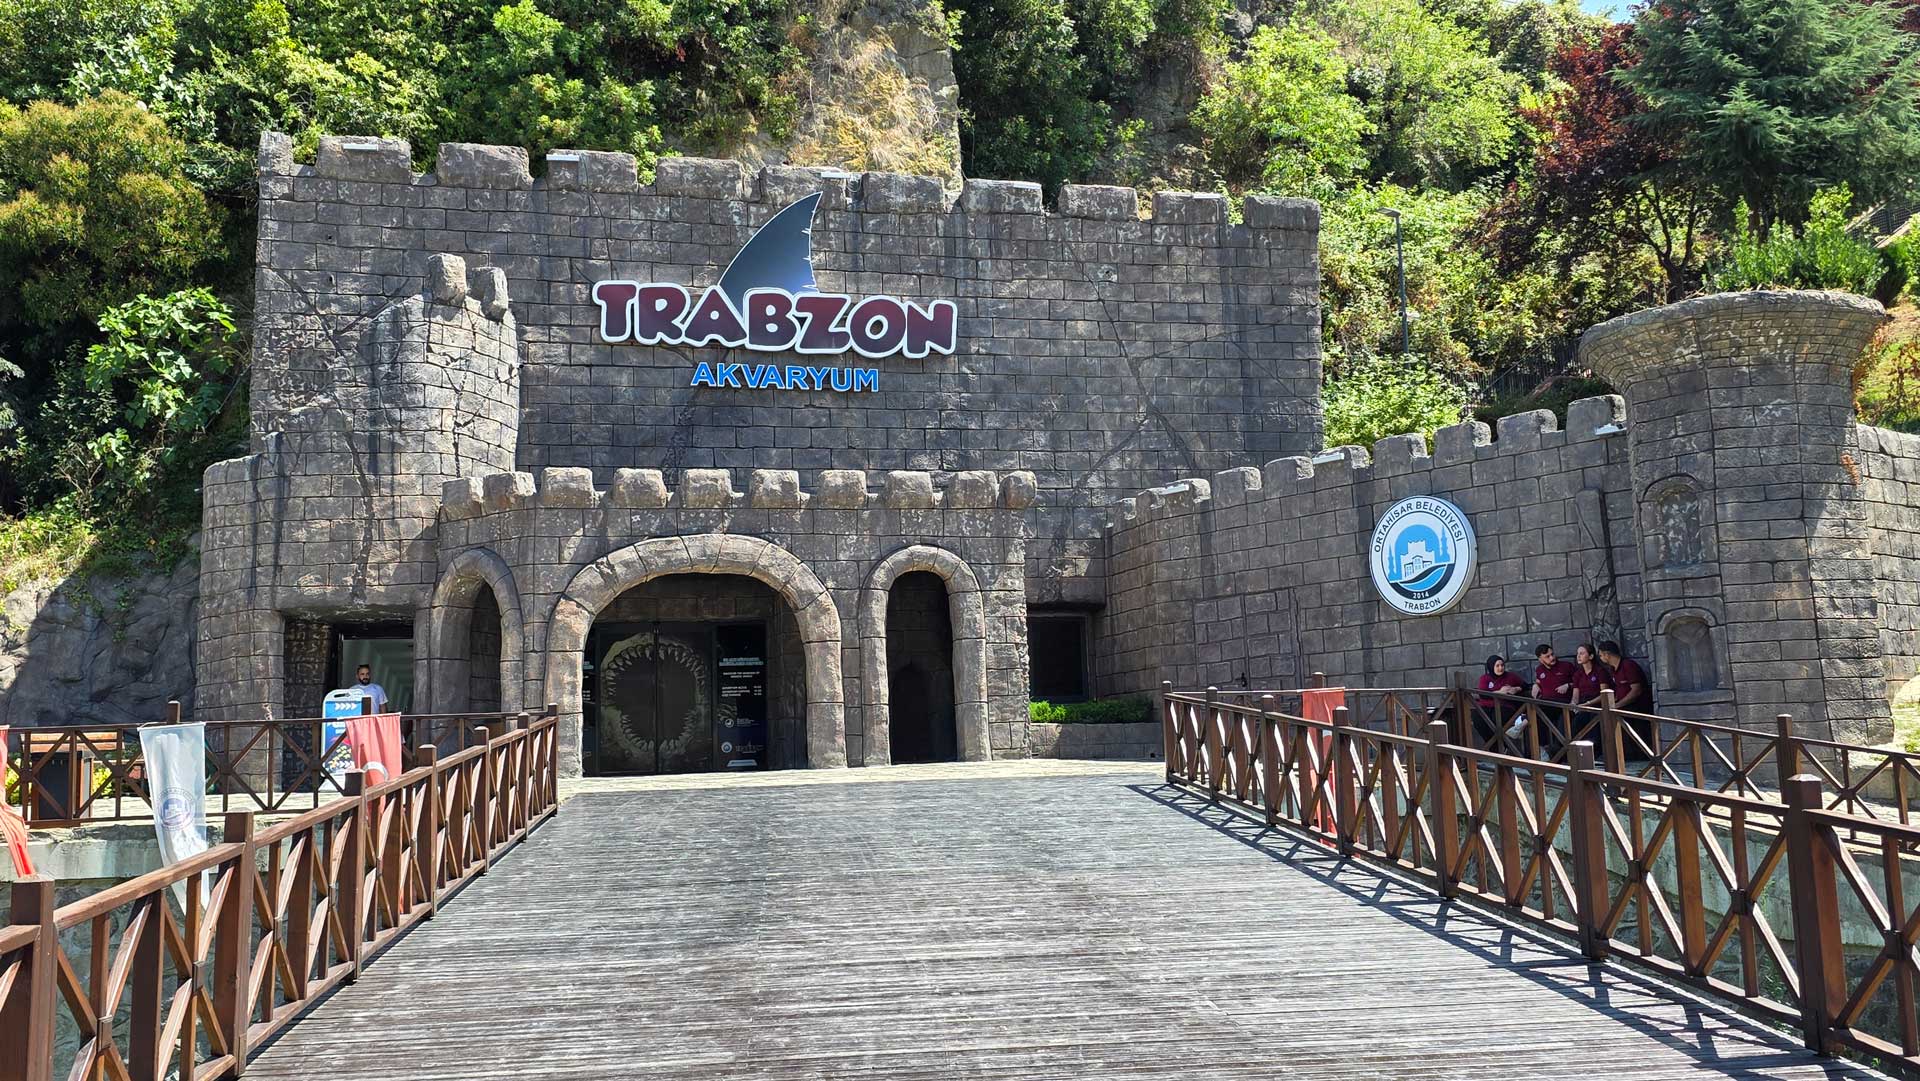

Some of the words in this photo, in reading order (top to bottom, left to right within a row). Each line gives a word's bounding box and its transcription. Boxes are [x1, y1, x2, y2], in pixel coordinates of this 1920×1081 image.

[592, 280, 958, 359] TRABZON
[691, 361, 879, 392] AKVARYUM
[1404, 598, 1441, 610] TRABZON
